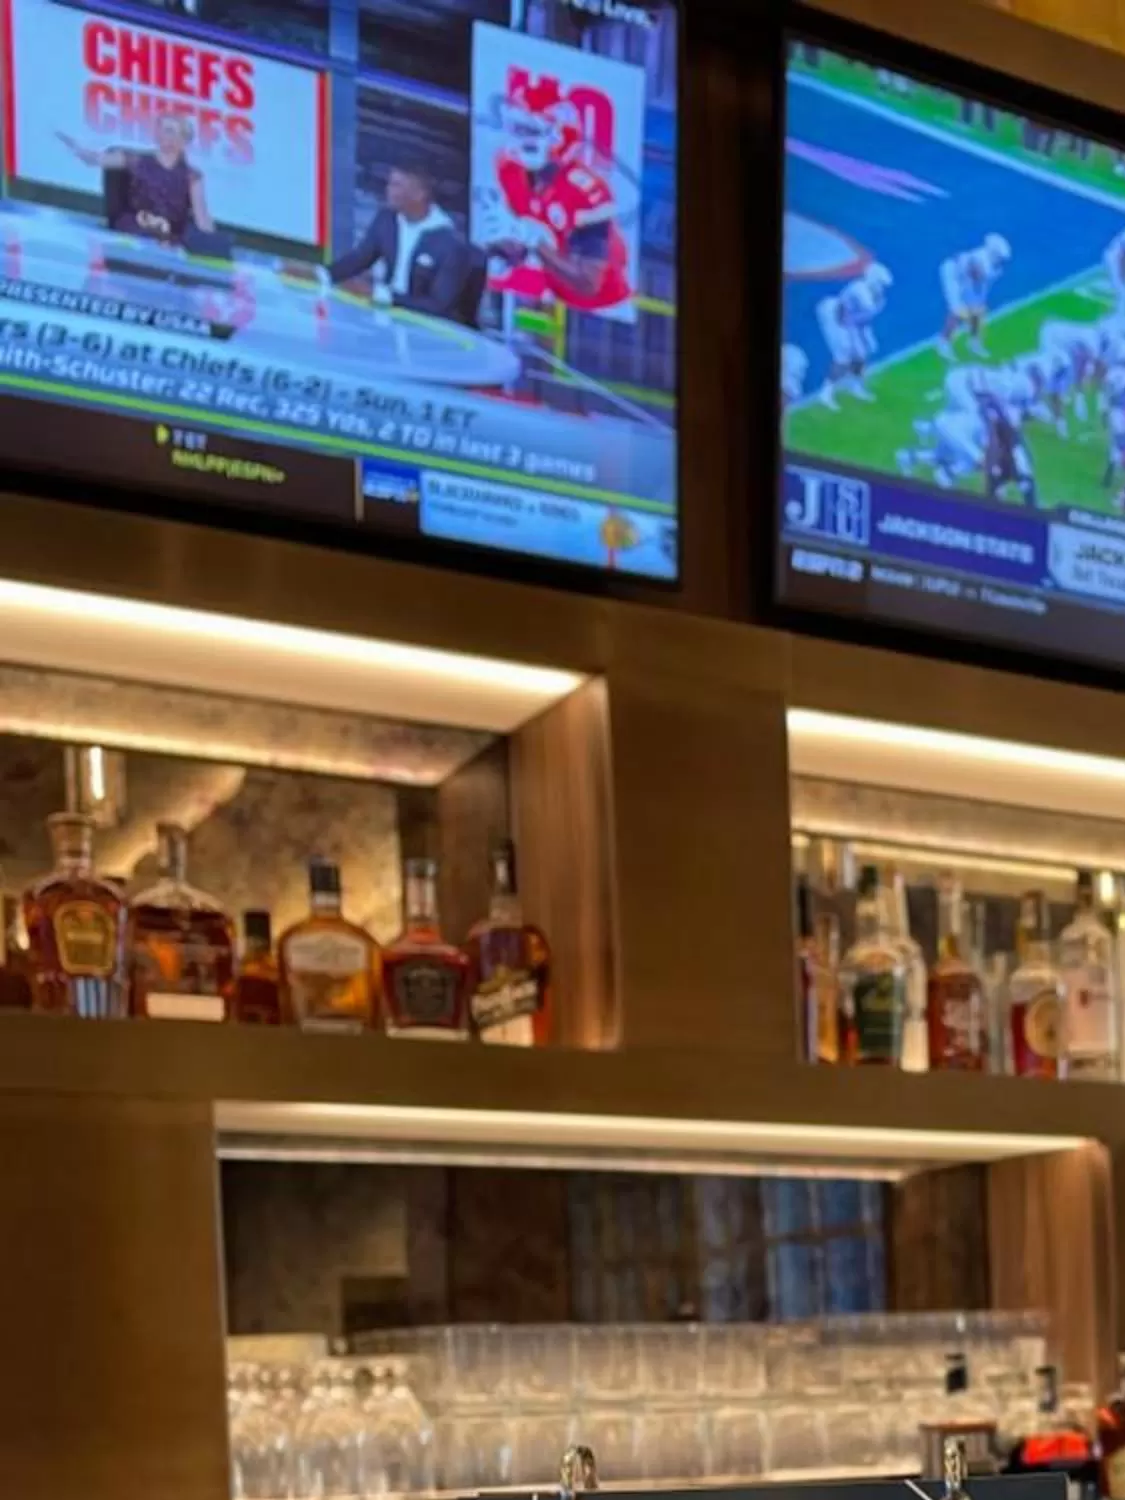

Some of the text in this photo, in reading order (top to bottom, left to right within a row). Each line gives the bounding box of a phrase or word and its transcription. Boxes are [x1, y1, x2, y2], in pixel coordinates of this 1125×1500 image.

[84, 20, 254, 110] CHIEFS
[0, 343, 174, 397] ith-Schuster:
[119, 340, 152, 364] at
[161, 344, 254, 385] Chiefs
[261, 366, 332, 403] (6-2)
